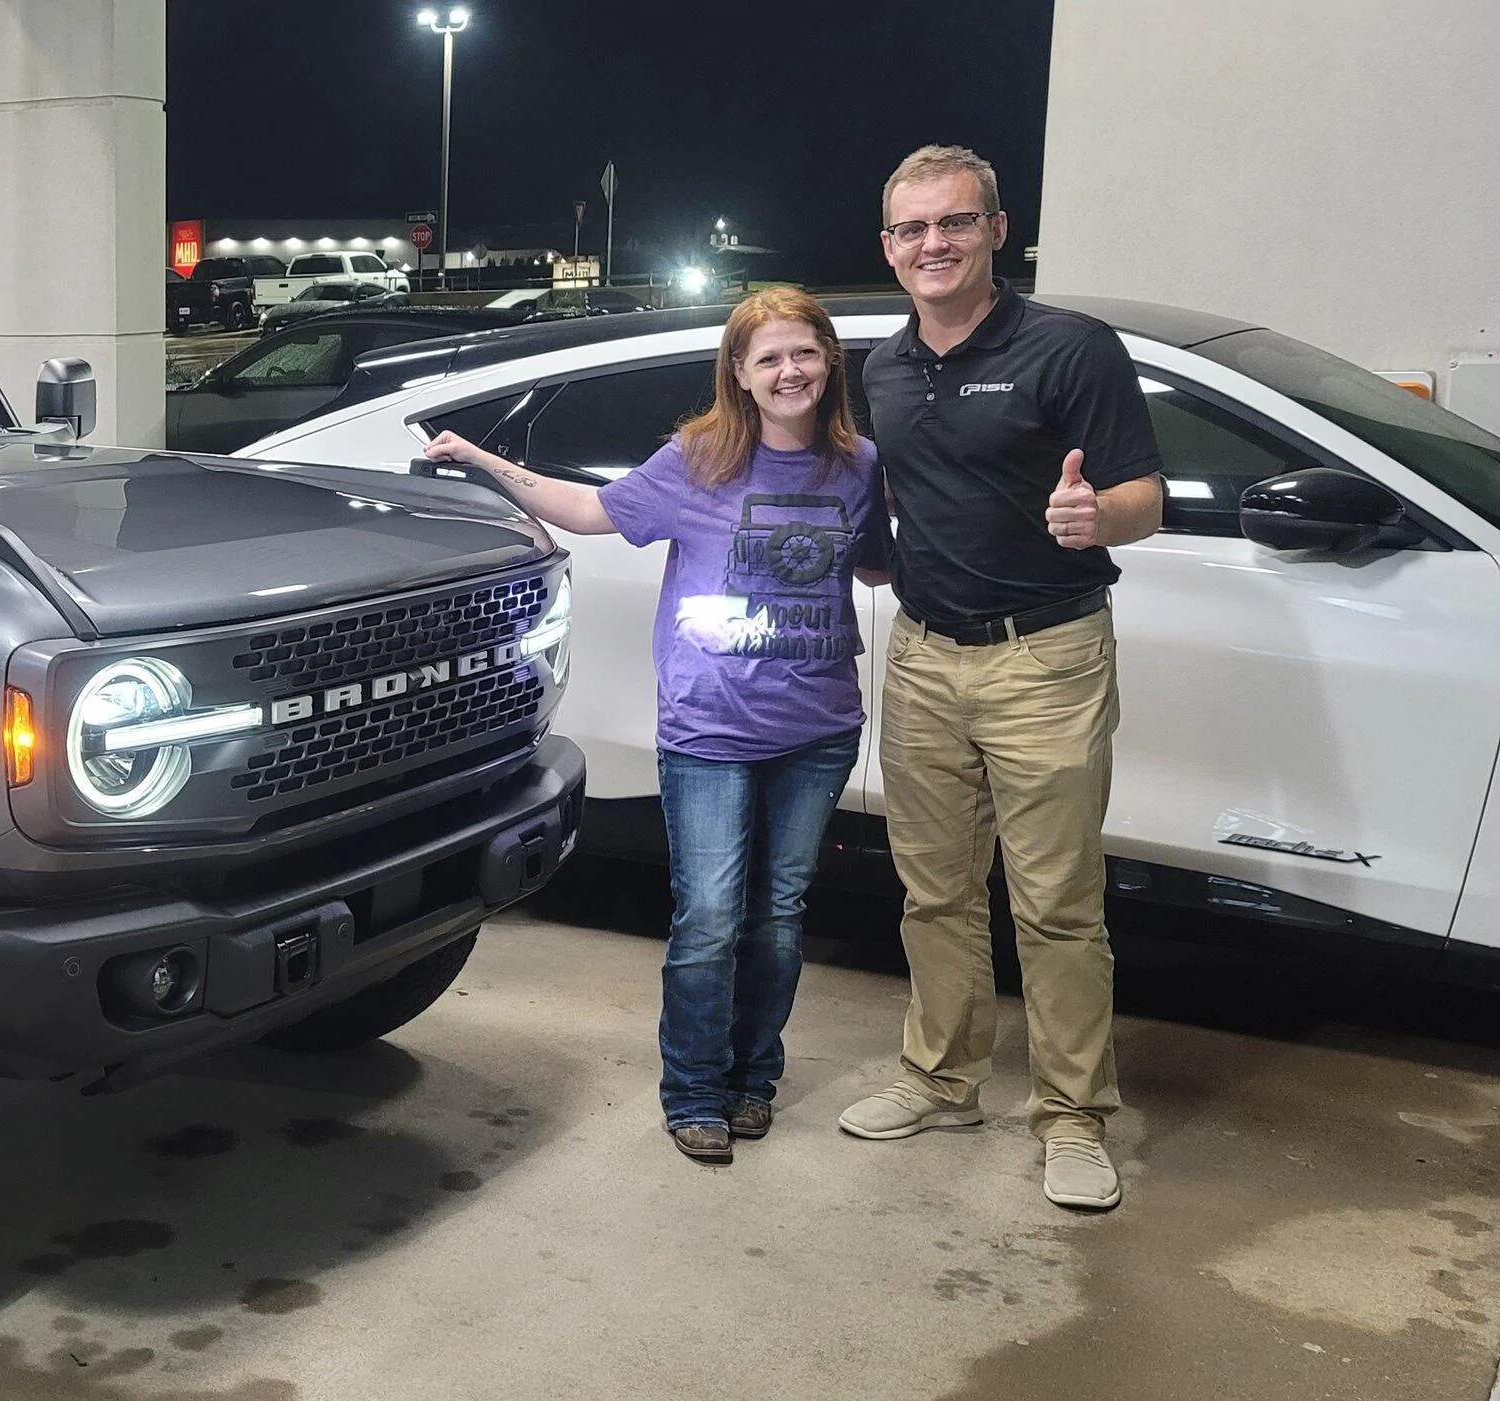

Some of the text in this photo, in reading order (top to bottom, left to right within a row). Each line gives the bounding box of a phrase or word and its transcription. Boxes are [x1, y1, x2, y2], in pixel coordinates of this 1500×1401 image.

[412, 231, 431, 242] STOP
[175, 242, 198, 264] MHD
[271, 640, 522, 725] BRONCO
